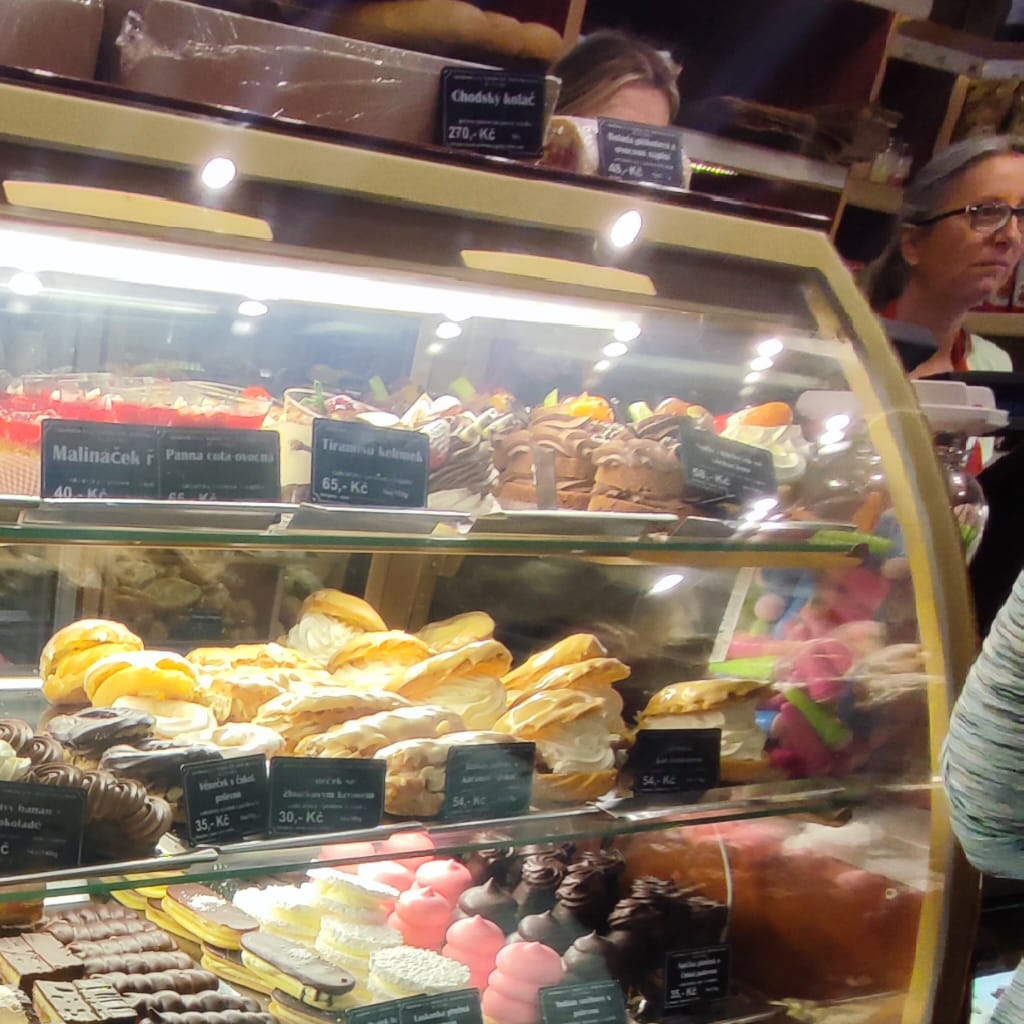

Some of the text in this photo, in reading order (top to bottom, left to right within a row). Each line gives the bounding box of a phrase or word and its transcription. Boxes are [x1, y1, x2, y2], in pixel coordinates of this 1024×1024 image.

[479, 127, 496, 142] Kč
[165, 448, 204, 463] Panna
[321, 477, 347, 494] 65,-
[350, 480, 369, 495] Kč
[195, 813, 231, 834] 35,- Kč
[278, 810, 324, 826] 30,- Kč
